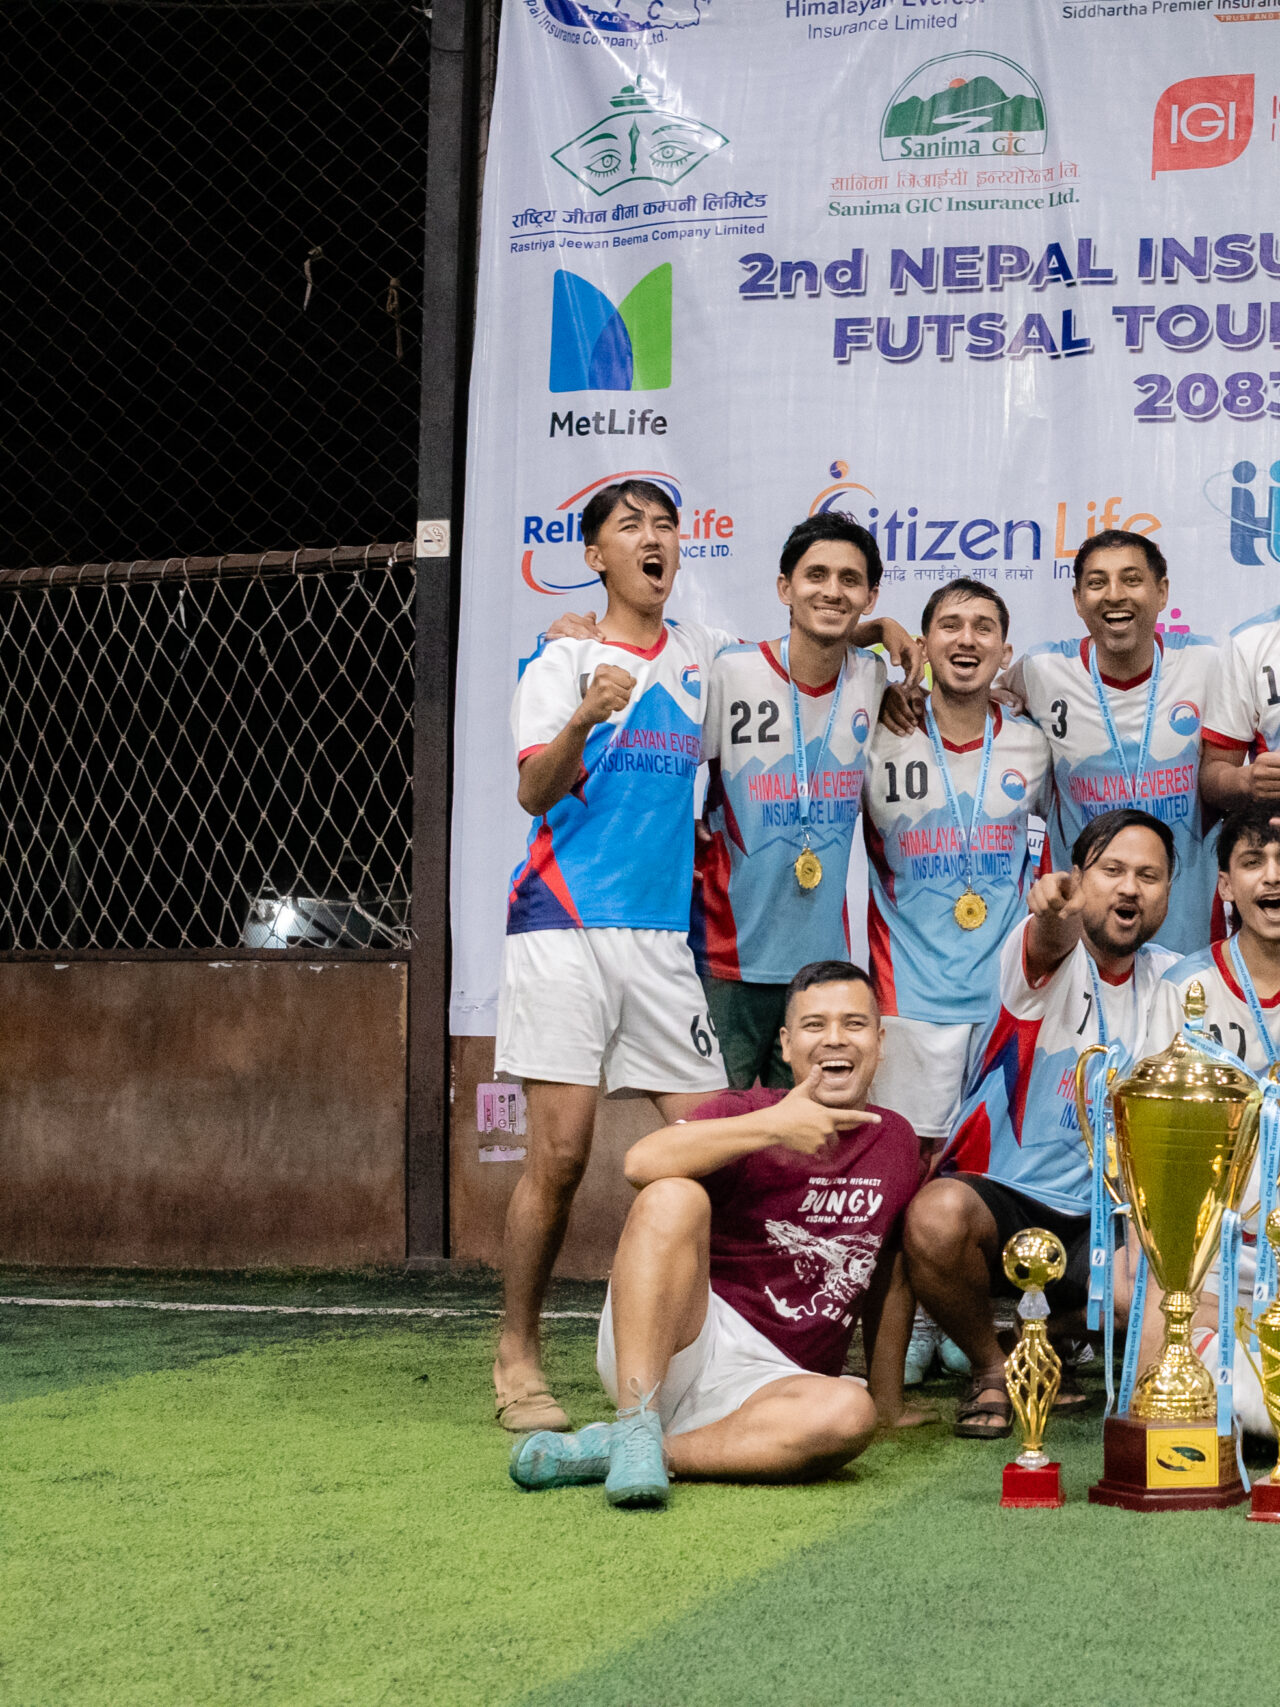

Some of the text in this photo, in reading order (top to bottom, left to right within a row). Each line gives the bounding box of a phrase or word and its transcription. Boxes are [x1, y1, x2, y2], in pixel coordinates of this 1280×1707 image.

[1063, 4, 1147, 19] Siddhartha
[1152, 0, 1210, 14] Premier
[1221, 14, 1250, 22] TRUST
[1254, 13, 1274, 21] AND
[808, 13, 957, 39] Insurance Limited
[1169, 103, 1236, 145] IGI
[900, 136, 980, 158] Sanima
[830, 172, 890, 192] सानिमा
[562, 208, 607, 225] जीवन
[612, 202, 639, 222] बीमा
[643, 195, 698, 215] कम्पनी
[703, 191, 768, 211] लिमिटेड
[828, 188, 1080, 217] Sanima GIC Insurance Ltd.
[510, 223, 765, 254] Rastriya Jeewan Beema Company Limited
[738, 247, 866, 300] 2nd
[889, 238, 1114, 292] NEPAL
[832, 308, 1094, 364] FUTSAL
[550, 409, 668, 438] MetLife
[523, 513, 583, 544] Reli
[711, 544, 733, 558] LTD.
[729, 699, 780, 745] 22
[1050, 698, 1068, 740] 3
[884, 760, 928, 803] 10
[762, 799, 824, 827] INSURACE
[911, 853, 972, 880] INSURANC
[1076, 991, 1093, 1035] 7
[850, 1177, 881, 1187] HIGHEST
[797, 1188, 883, 1217] BUNGY
